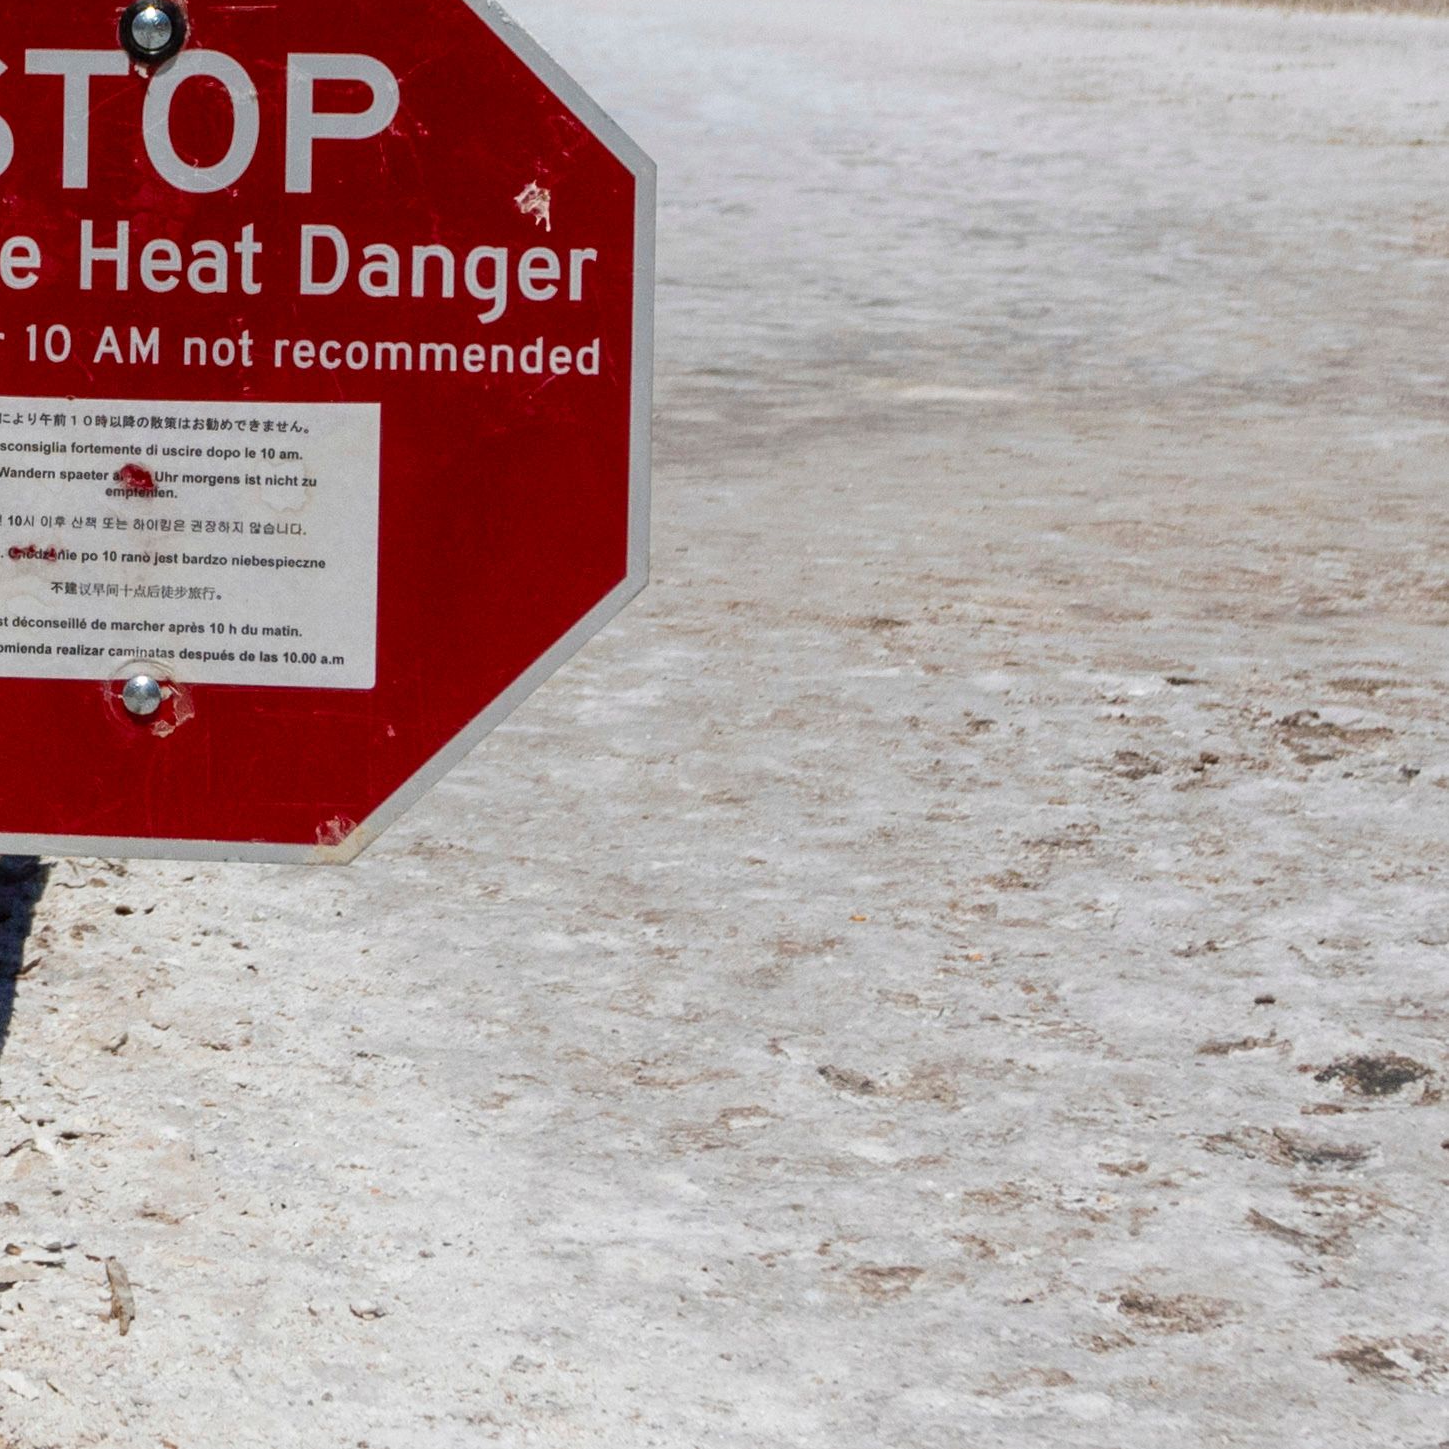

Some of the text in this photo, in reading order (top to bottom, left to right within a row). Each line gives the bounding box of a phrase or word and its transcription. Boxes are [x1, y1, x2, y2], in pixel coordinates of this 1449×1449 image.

[79, 219, 263, 294] Heat
[300, 224, 597, 324] Danger
[27, 324, 72, 363] 10
[94, 326, 160, 364] AM
[183, 330, 254, 367] not
[274, 337, 600, 376] recommended
[0, 442, 67, 455] sconsiglia
[71, 442, 142, 455] fortemente
[146, 444, 158, 456] di
[162, 446, 202, 457] uscire
[206, 446, 241, 460] dopo
[245, 447, 256, 458] le
[261, 448, 275, 459] 10
[279, 451, 302, 460] am.
[60, 470, 109, 482] spaeter
[154, 471, 179, 483] Uhr
[182, 475, 240, 487] morgens
[245, 474, 261, 485] ist
[265, 475, 298, 486] nicht
[302, 478, 317, 487] zu
[8, 515, 34, 526] 10시
[41, 516, 65, 527] 이후
[72, 517, 96, 529] 산책
[103, 517, 128, 530] 또는
[133, 518, 185, 532] 하이킹은
[191, 520, 243, 533] 권장하지
[249, 522, 306, 535] 않습니다.
[81, 552, 98, 563] po
[103, 551, 117, 562] 10
[153, 552, 178, 566] jest
[182, 553, 228, 565] bardzo
[232, 555, 326, 569] niebespieczne
[12, 616, 87, 629] déconseillé
[91, 619, 107, 630] de
[111, 621, 165, 632] marcher
[168, 622, 205, 635] après
[210, 623, 224, 634] 10
[229, 624, 237, 634] h
[241, 624, 258, 635] du
[262, 626, 302, 637] matin.
[57, 645, 104, 656] realizar
[108, 646, 175, 659] caminatas
[179, 648, 235, 662] después
[239, 651, 255, 662] de
[259, 651, 278, 663] las
[283, 652, 317, 664] 10.00
[320, 656, 344, 665] a.m
